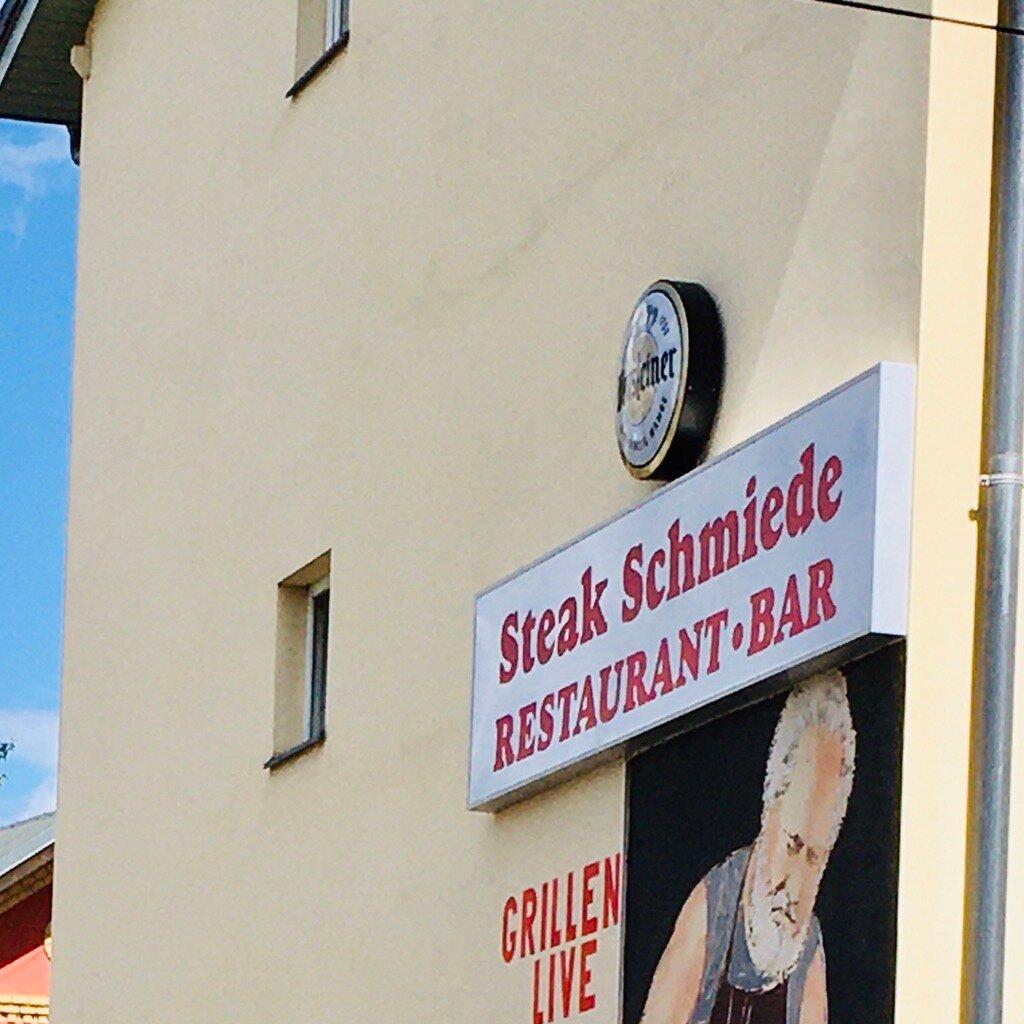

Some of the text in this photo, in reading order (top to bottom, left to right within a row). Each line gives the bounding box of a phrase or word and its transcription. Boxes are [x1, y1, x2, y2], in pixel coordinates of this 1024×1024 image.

[499, 442, 843, 685] Steak Schmiede
[501, 852, 621, 963] GRILLEN
